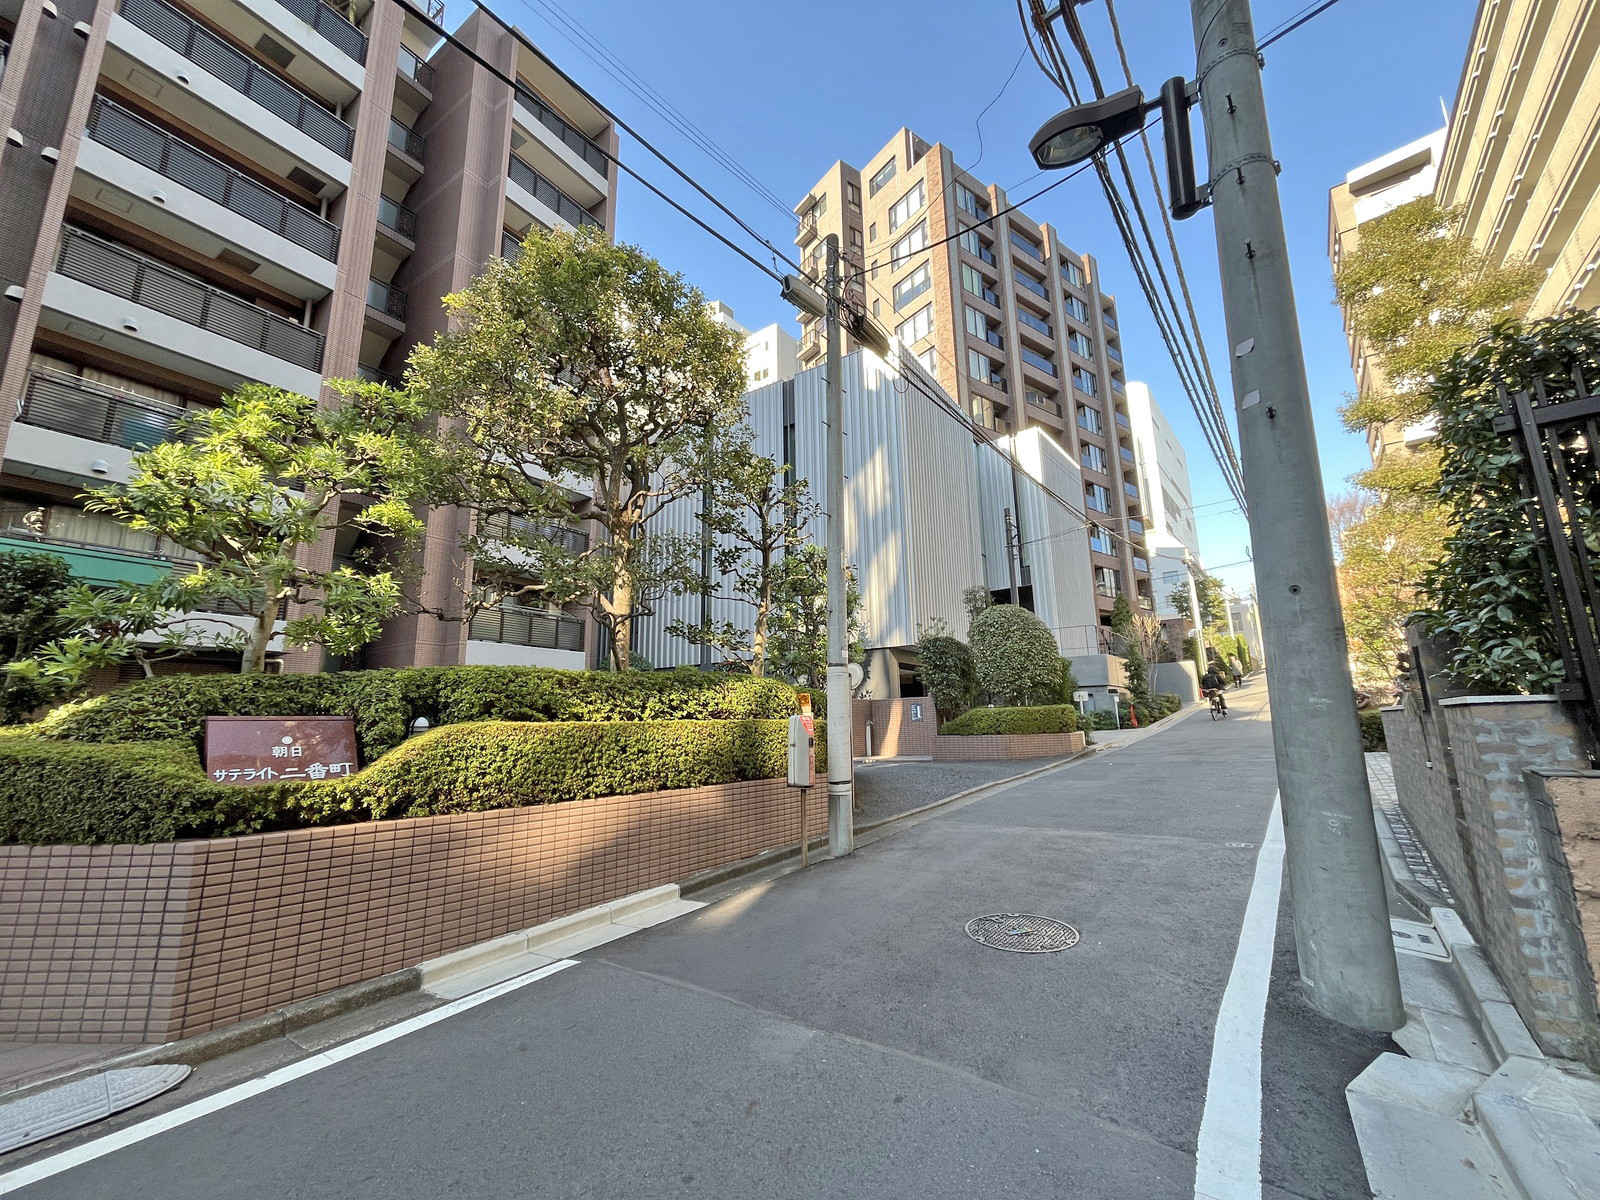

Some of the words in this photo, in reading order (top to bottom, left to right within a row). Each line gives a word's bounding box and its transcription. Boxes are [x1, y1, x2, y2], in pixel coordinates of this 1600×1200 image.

[271, 746, 302, 758] 朝日
[213, 762, 354, 782] サテライト二番町
